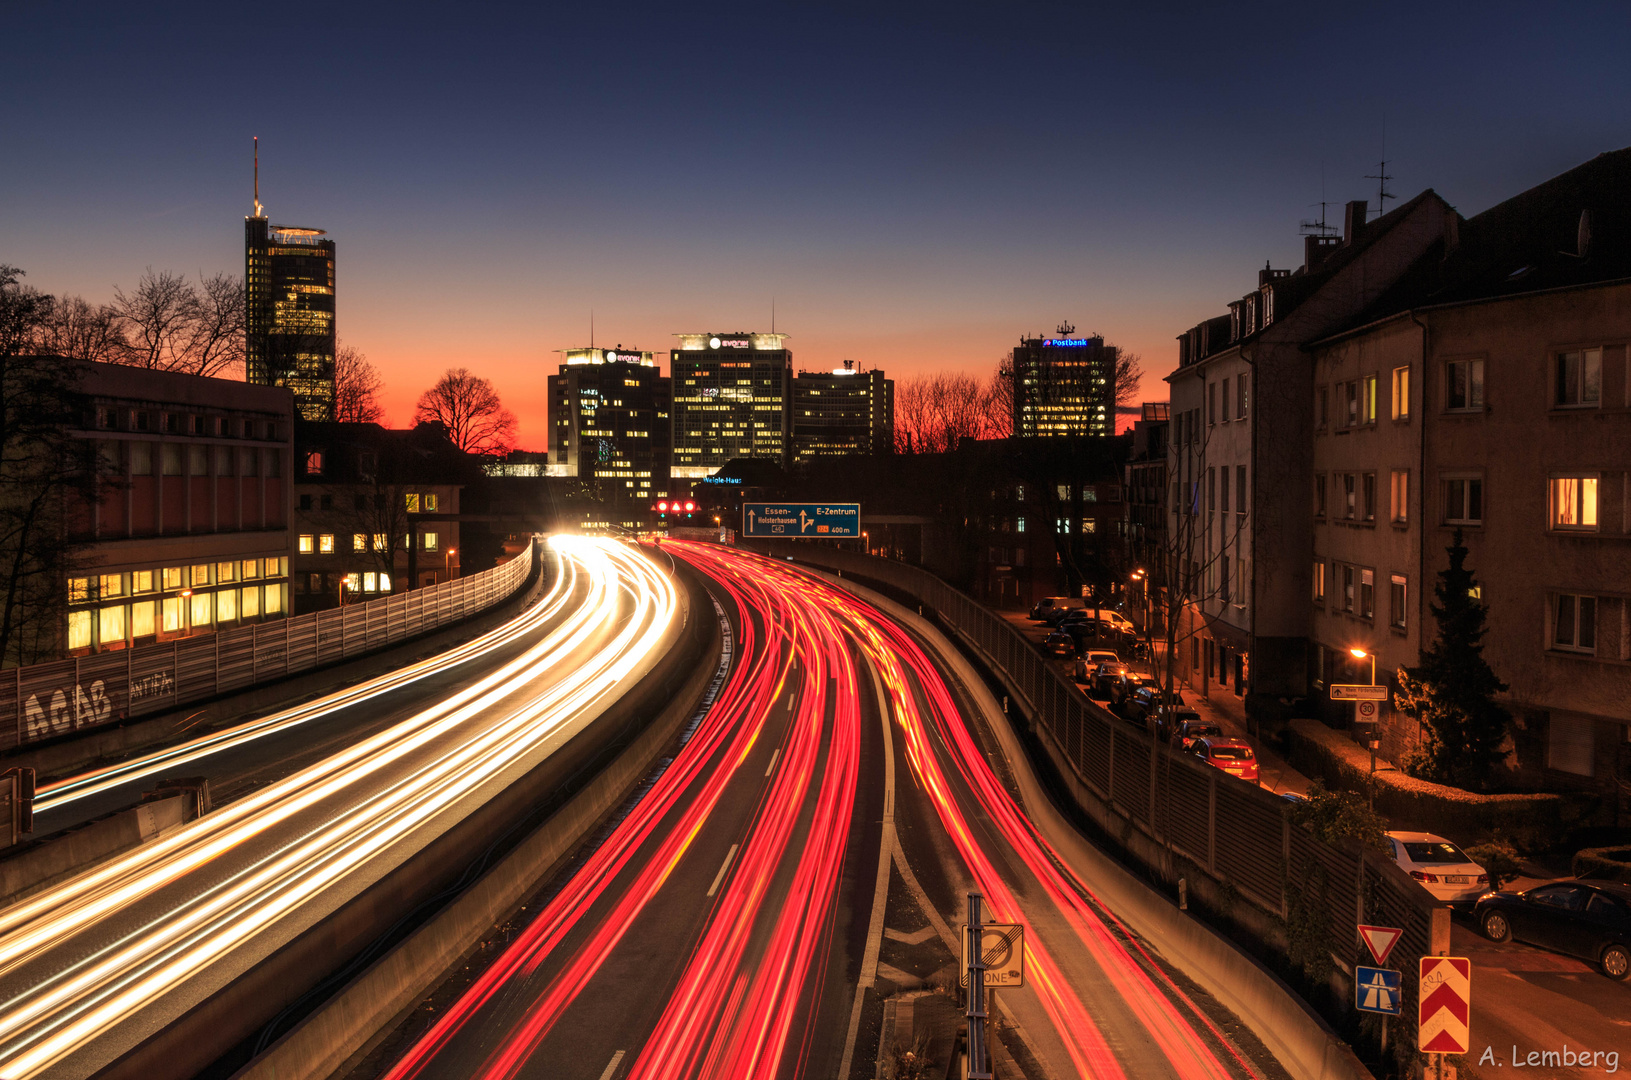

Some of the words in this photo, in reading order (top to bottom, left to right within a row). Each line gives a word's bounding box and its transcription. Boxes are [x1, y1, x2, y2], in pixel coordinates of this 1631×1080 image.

[1052, 338, 1087, 347] Postbank
[765, 507, 792, 515] Essen-
[816, 507, 856, 515] E-Zentrum
[1362, 705, 1372, 713] 30
[983, 972, 1008, 983] ONE
